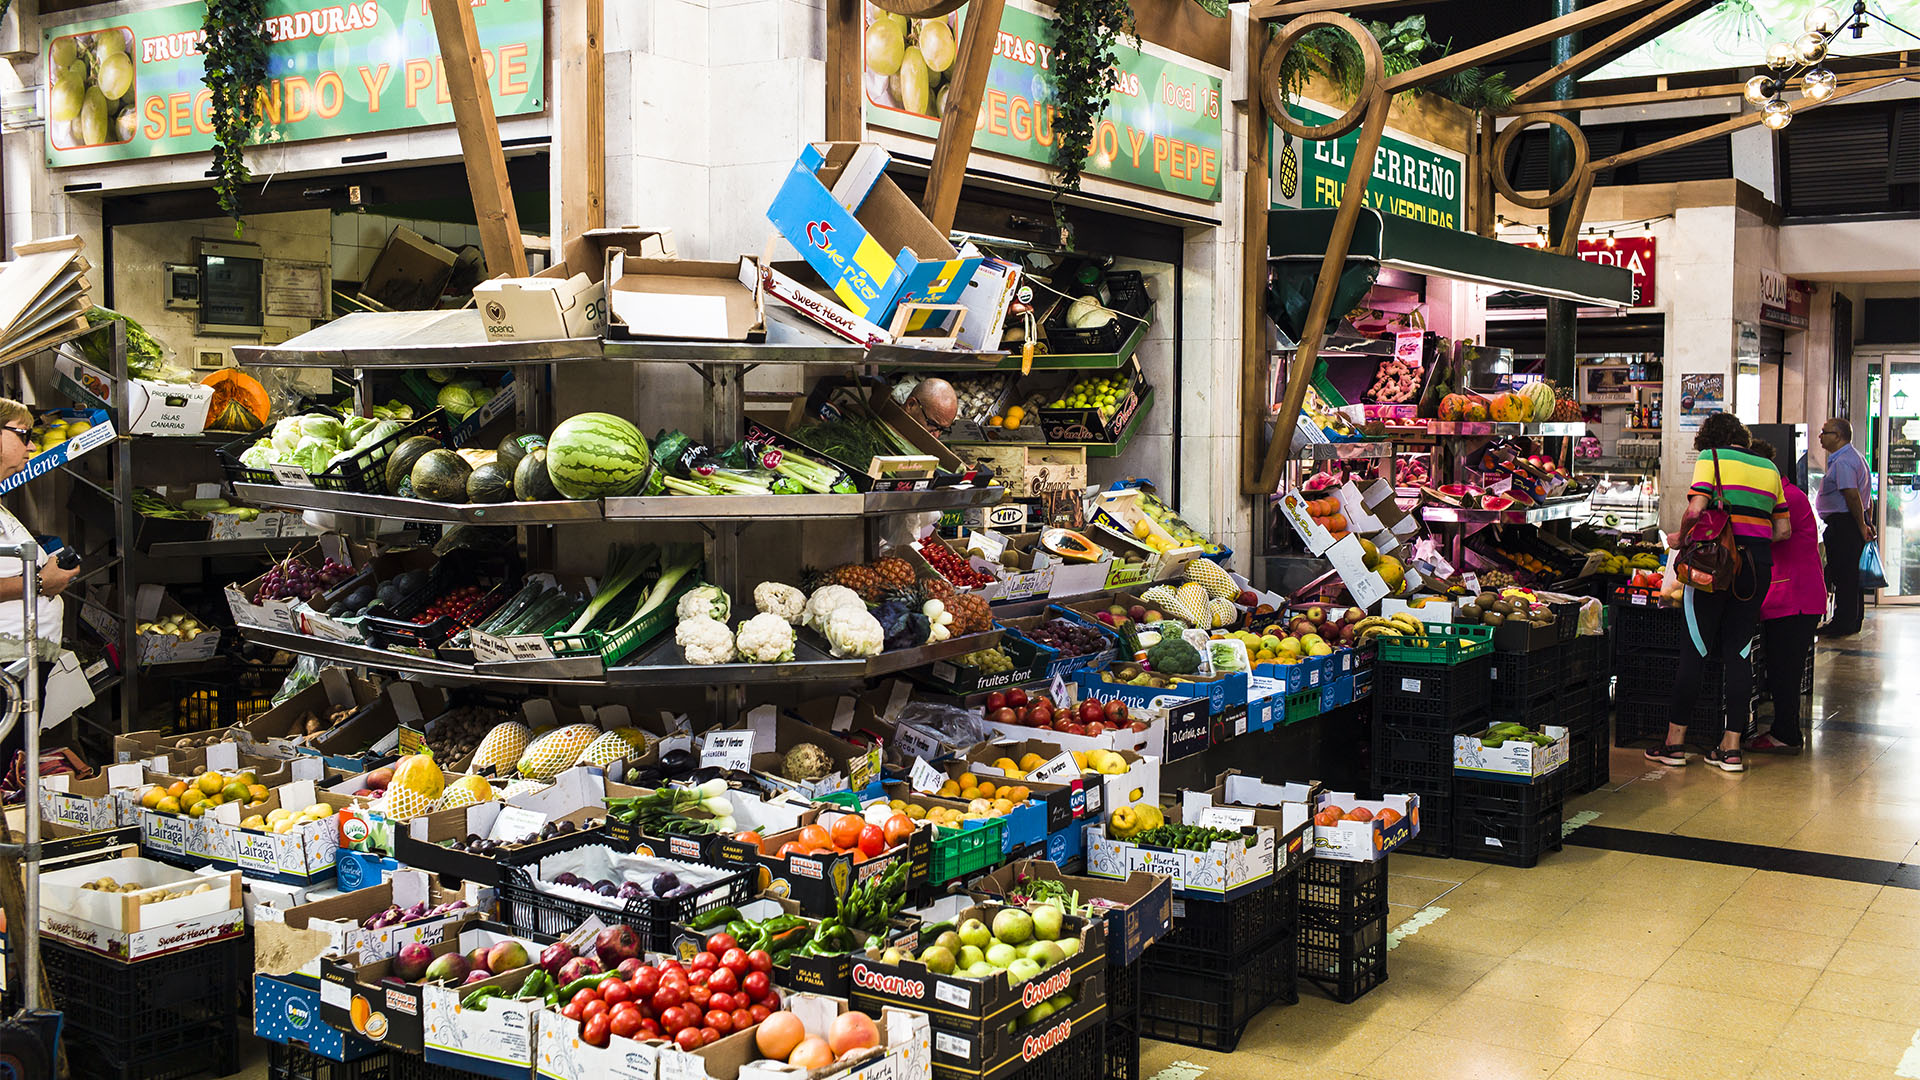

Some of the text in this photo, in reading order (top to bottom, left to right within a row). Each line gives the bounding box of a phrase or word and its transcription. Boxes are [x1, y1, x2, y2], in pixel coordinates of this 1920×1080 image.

[1037, 43, 1051, 70] Y
[358, 63, 390, 113] Y
[1162, 72, 1196, 113] local
[1201, 88, 1219, 119] 15
[1127, 126, 1145, 168] Y
[1153, 134, 1216, 187] PEPE
[1314, 128, 1456, 201] EL ERREÑO
[791, 289, 857, 331] Sweet Heart
[150, 420, 186, 430] CANARIAS
[161, 413, 181, 421] ISLAS
[977, 669, 1032, 690] fruites font
[58, 805, 89, 825] Lairaga
[164, 819, 182, 832] Huerta
[148, 822, 183, 846] Lairaga
[252, 838, 271, 850] Huerta
[238, 840, 274, 863] Lairaga
[722, 845, 743, 854] CANARY
[1153, 854, 1180, 867] Huerta
[1130, 857, 1180, 877] Lairaga
[47, 917, 98, 946] Sweet Heart
[157, 925, 216, 947] Sweet Heart
[796, 975, 825, 987] LA PALMA
[798, 969, 822, 980] ISLA DE
[852, 963, 925, 999] Cosanse
[1022, 967, 1071, 1009] Cosanse
[287, 1004, 308, 1019] Bonny
[1022, 1018, 1071, 1062] Cosanse
